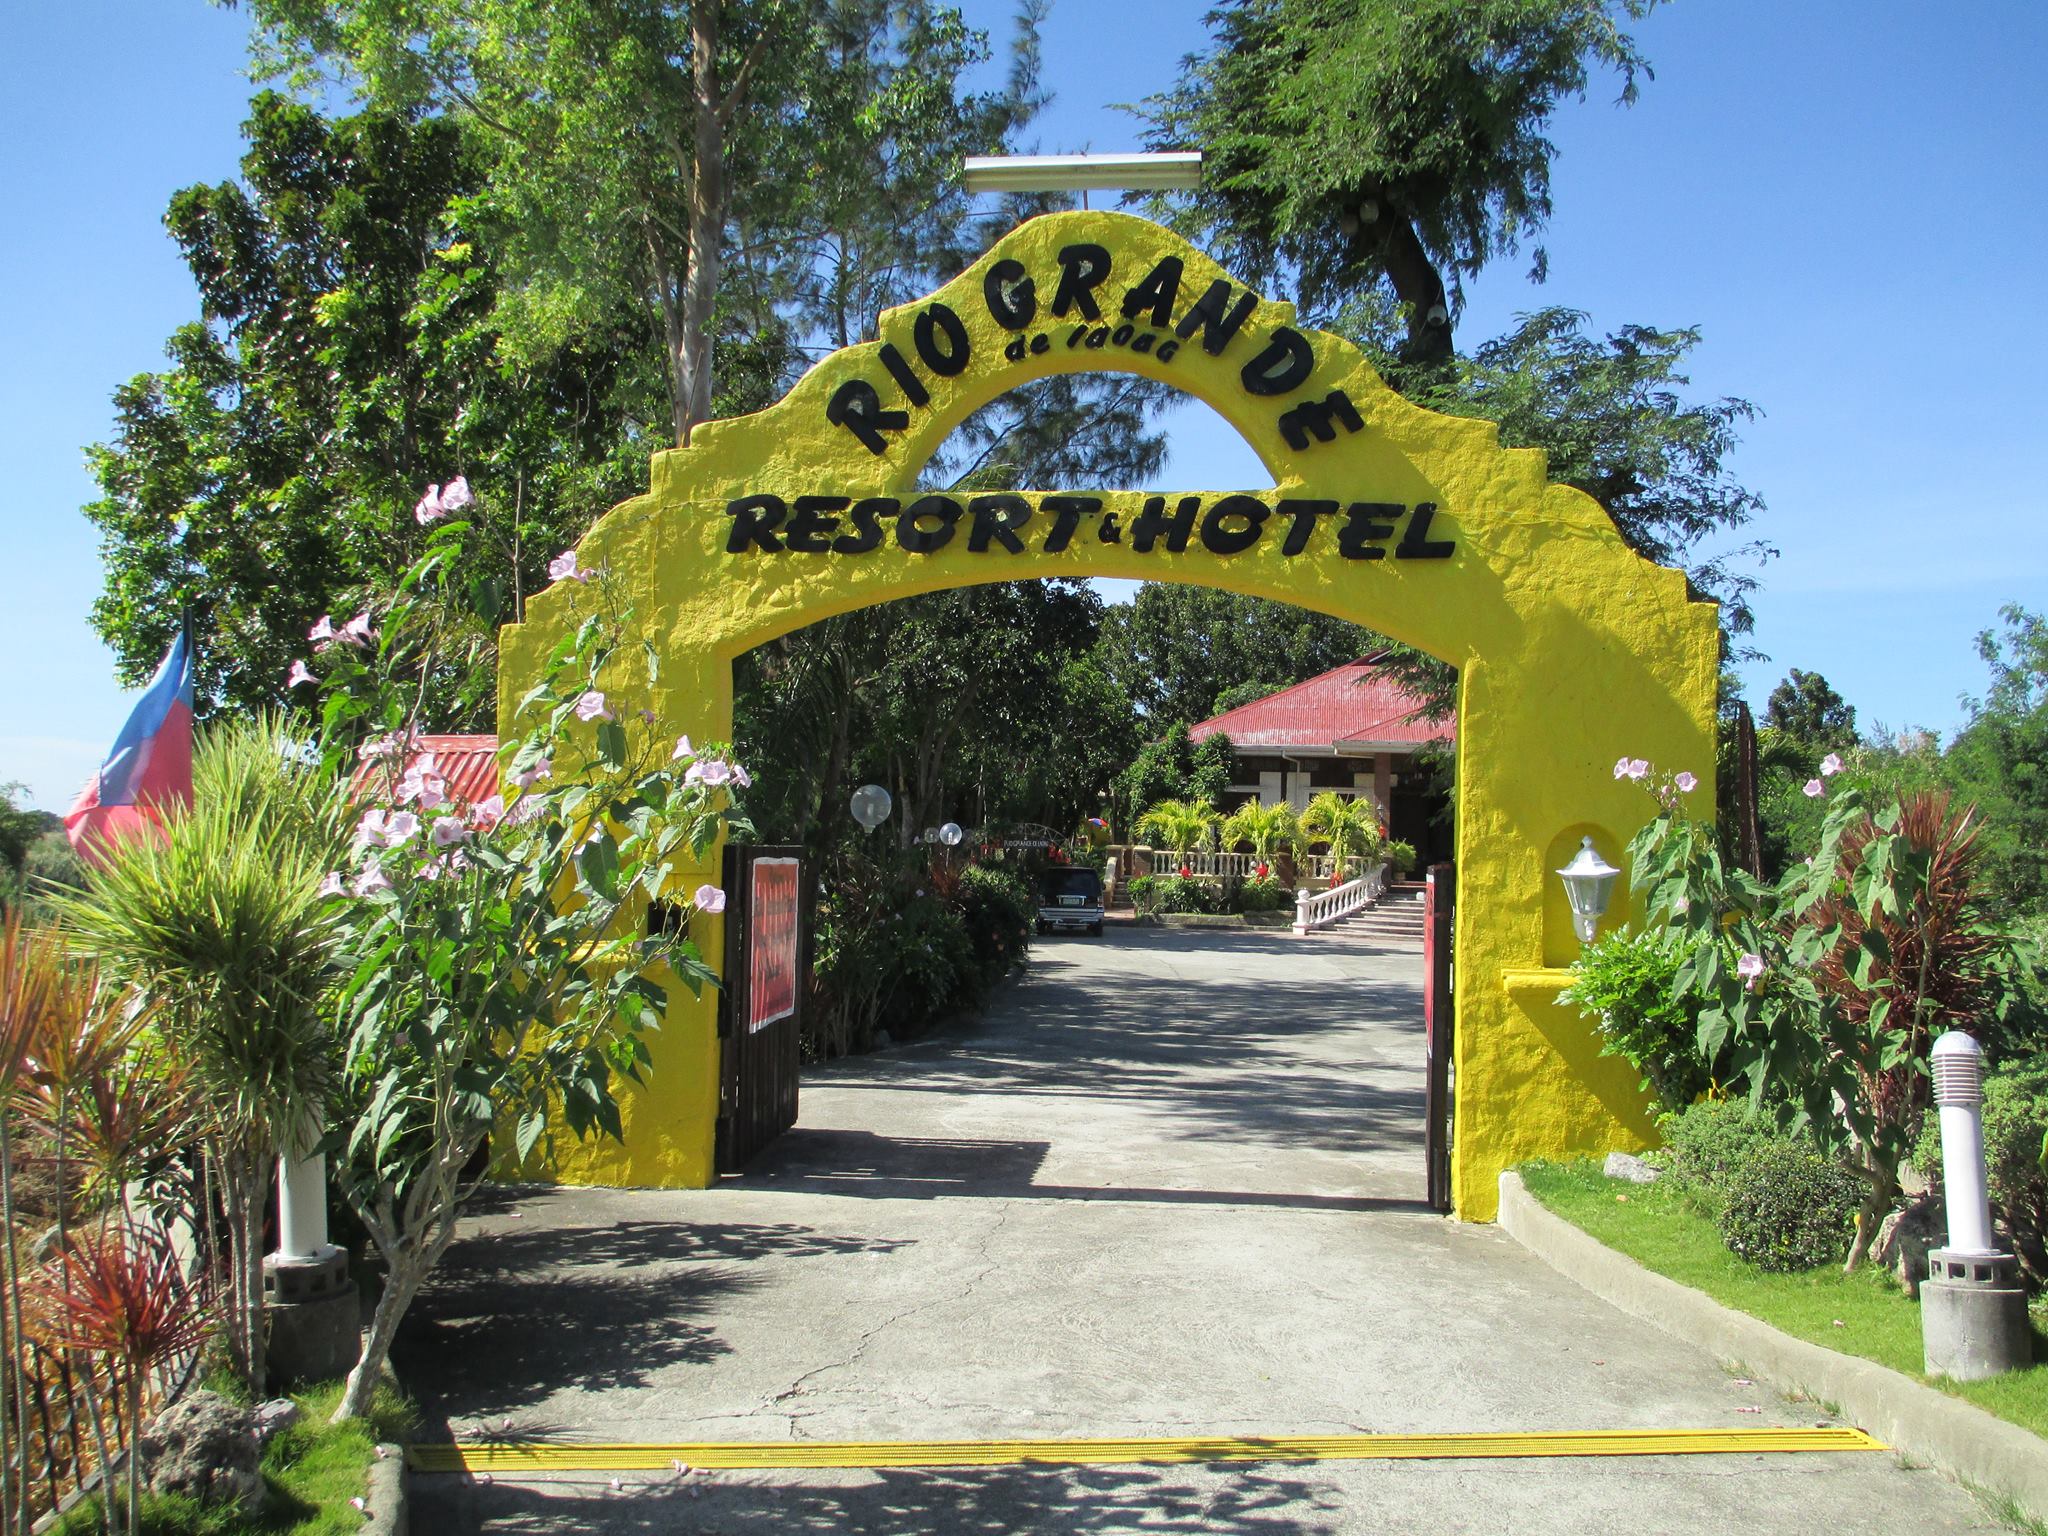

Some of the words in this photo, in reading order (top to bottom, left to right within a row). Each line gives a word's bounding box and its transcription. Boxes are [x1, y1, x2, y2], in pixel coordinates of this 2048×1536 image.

[826, 303, 970, 455] RIO
[984, 244, 1364, 451] GRANDE
[726, 495, 1103, 554] RESORT
[1099, 513, 1121, 544] &
[1131, 495, 1456, 560] HOTEL
